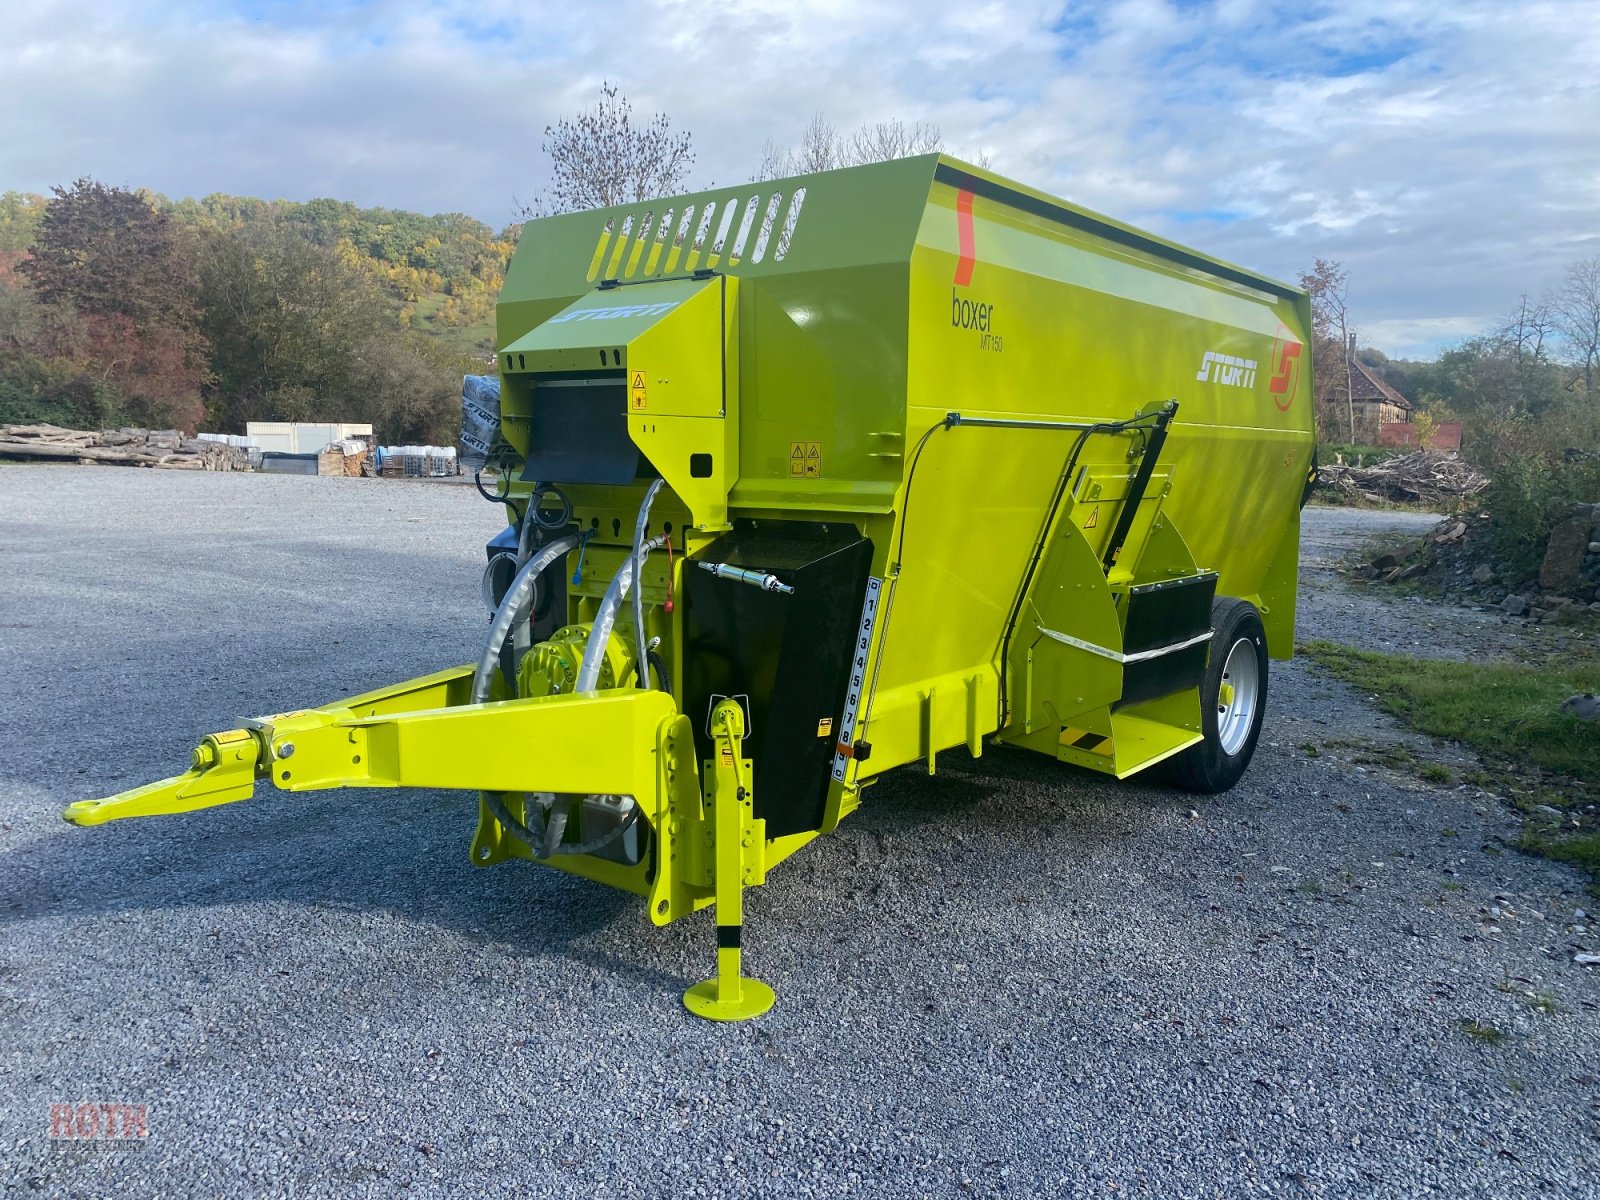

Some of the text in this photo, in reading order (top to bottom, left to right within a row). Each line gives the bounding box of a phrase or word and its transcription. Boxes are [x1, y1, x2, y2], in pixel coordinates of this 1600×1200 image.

[549, 301, 681, 324] STORTI
[952, 287, 994, 333] boxer
[1196, 351, 1258, 389] STORTI
[868, 600, 874, 611] 1
[863, 618, 871, 630] 2
[860, 637, 867, 649] 3
[856, 656, 864, 668] 4
[853, 675, 860, 687] 5
[850, 694, 856, 706] 6
[847, 712, 853, 724] 7
[842, 731, 849, 743] 8
